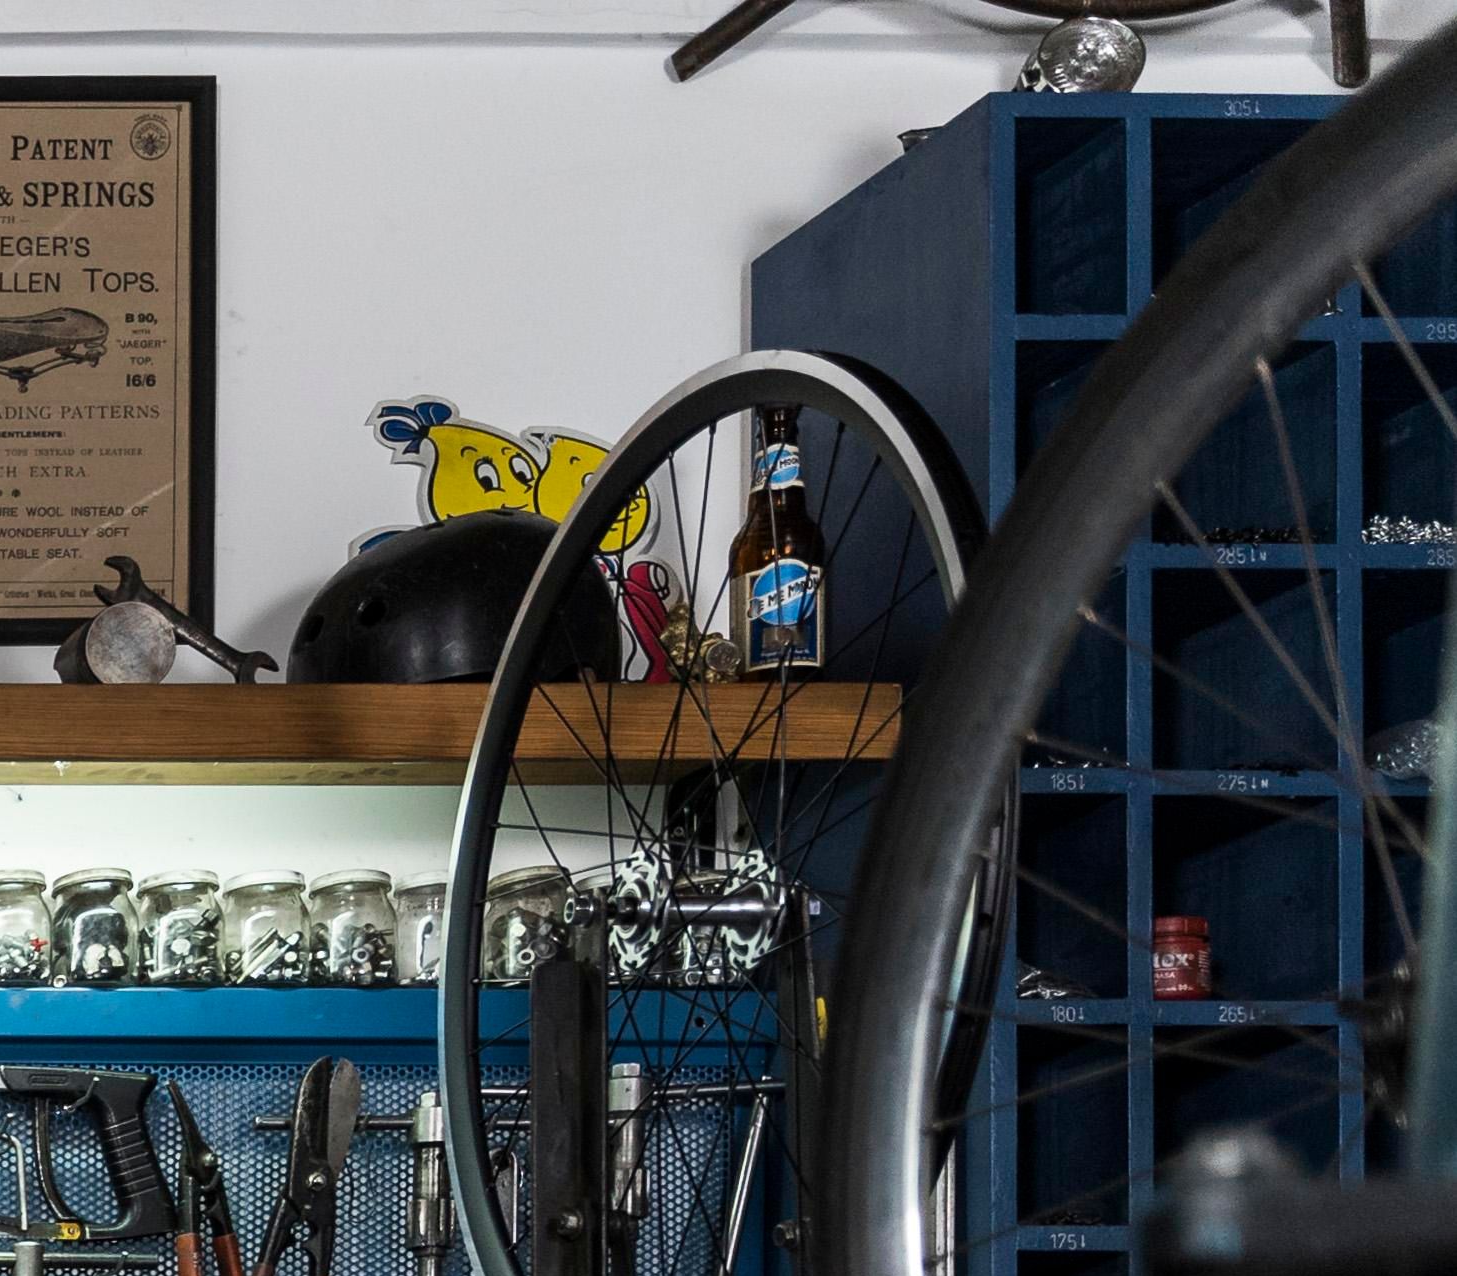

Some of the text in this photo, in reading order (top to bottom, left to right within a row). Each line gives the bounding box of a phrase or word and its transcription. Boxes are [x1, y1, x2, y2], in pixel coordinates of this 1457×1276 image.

[11, 135, 113, 160] PATENT
[22, 181, 155, 208] SPRINGS
[82, 268, 159, 293] TOPS.
[60, 404, 161, 420] PATTERNS
[25, 506, 63, 517] WOOL
[70, 506, 124, 517] INSTEAD
[131, 505, 149, 516] OF
[96, 526, 130, 538] SOFT
[1427, 548, 1455, 566] 285
[1050, 773, 1078, 790] 185
[1218, 774, 1247, 791] 275
[1050, 1006, 1077, 1023] 180
[1218, 1005, 1247, 1022] 265
[1050, 1233, 1077, 1250] 175
